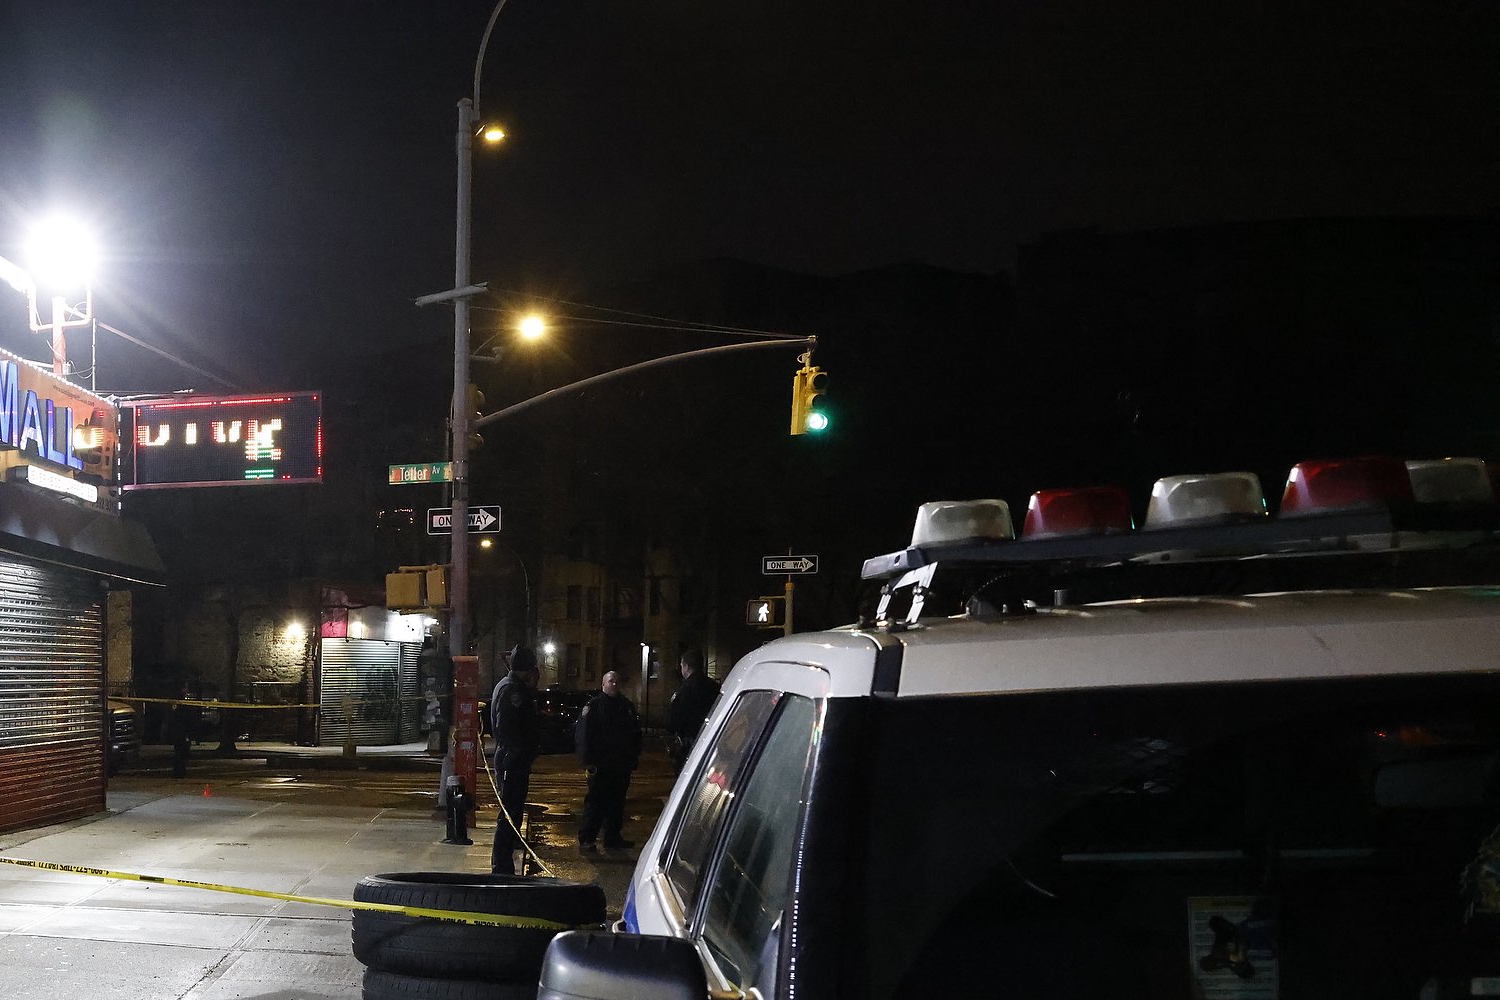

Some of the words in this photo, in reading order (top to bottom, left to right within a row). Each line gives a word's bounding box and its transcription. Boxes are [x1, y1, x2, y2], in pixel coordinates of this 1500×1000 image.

[399, 466, 430, 482] Teller
[431, 465, 441, 475] Av
[770, 561, 787, 569] ONE
[792, 561, 810, 569] WAY
